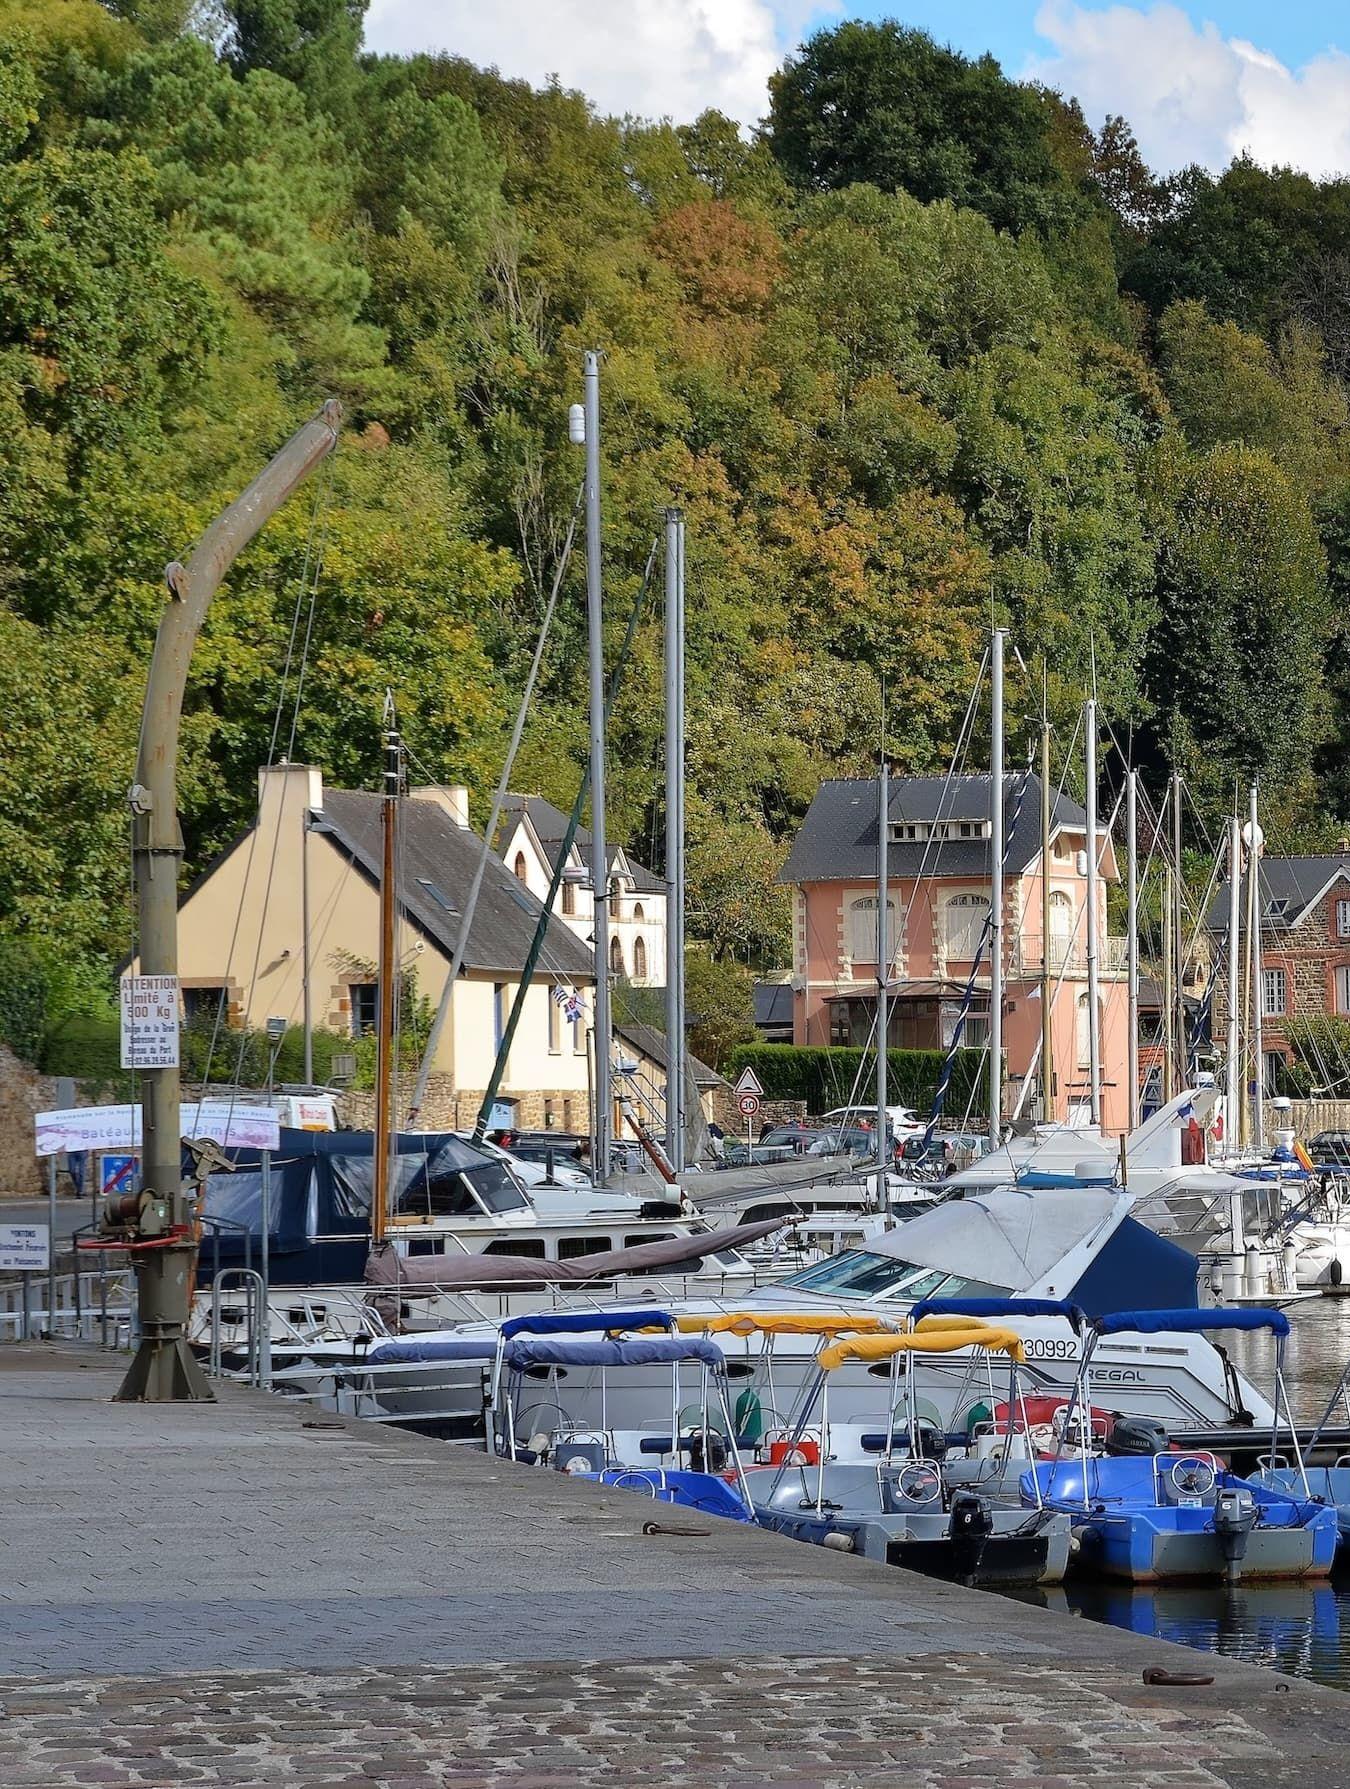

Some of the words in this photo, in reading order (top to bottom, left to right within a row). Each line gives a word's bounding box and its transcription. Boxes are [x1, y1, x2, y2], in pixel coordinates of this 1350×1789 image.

[122, 978, 177, 990] ATTENTION
[124, 991, 159, 1004] Lmité
[127, 1006, 148, 1018] 500
[157, 1006, 170, 1020] Kg
[743, 1100, 755, 1110] 30
[1017, 1338, 1078, 1359] 30992
[1221, 1501, 1232, 1510] 6
[964, 1513, 972, 1524] 6
